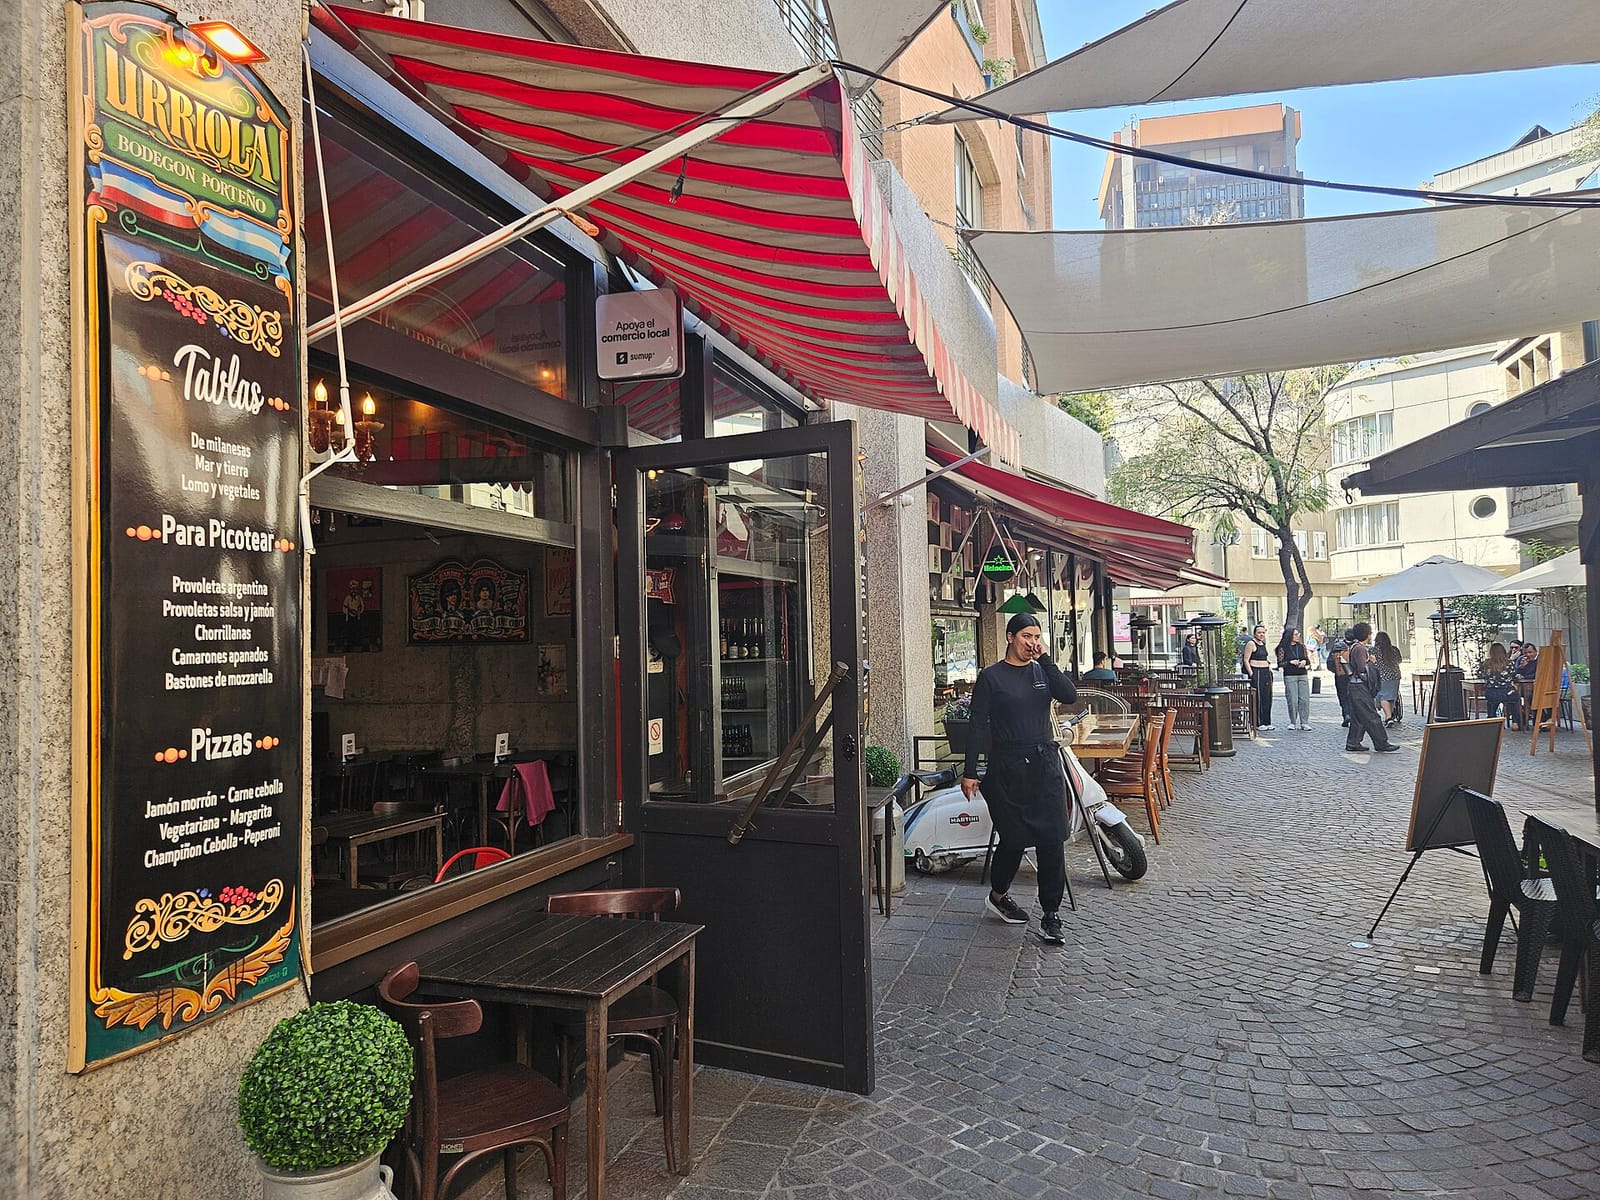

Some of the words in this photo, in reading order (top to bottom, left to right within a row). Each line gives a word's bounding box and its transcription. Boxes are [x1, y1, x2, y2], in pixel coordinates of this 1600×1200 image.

[104, 42, 276, 185] URRIOLA
[117, 134, 196, 183] BODEGON
[201, 172, 267, 214] PORTEÑO
[601, 330, 646, 343] comercio
[647, 327, 670, 339] local
[616, 321, 645, 332] Apoya
[646, 318, 655, 328] el
[173, 344, 265, 415] Tablas
[191, 432, 205, 449] De
[206, 437, 252, 457] milanesas
[195, 455, 215, 472] Mar
[216, 463, 222, 477] y
[223, 460, 249, 477] tierra
[181, 474, 209, 493] Lomo
[211, 484, 219, 498] y
[218, 484, 260, 501] vegetales
[162, 514, 206, 547] Para
[209, 518, 275, 552] Picotear
[172, 575, 226, 595] Provoletas
[227, 580, 268, 599] argentina
[162, 600, 218, 618] Provoletas
[219, 602, 243, 618] salsa
[243, 607, 250, 622] y
[250, 602, 275, 621] jamón
[194, 624, 251, 641] Chorrillanas
[172, 648, 228, 666] Camarones
[228, 646, 269, 667] apanados
[165, 672, 214, 690] Bastones
[214, 671, 226, 687] de
[227, 668, 273, 686] mozzarella
[191, 727, 253, 762] Pizzas
[144, 797, 180, 819] Jamón
[180, 790, 218, 812] morrón
[227, 786, 254, 804] Carne
[254, 779, 283, 798] cebolla
[159, 816, 220, 843] Vegetariana
[230, 804, 273, 827] Margarita
[144, 842, 202, 868] Champiñon
[203, 833, 238, 855] Cebolla
[244, 822, 281, 847] Peperoni
